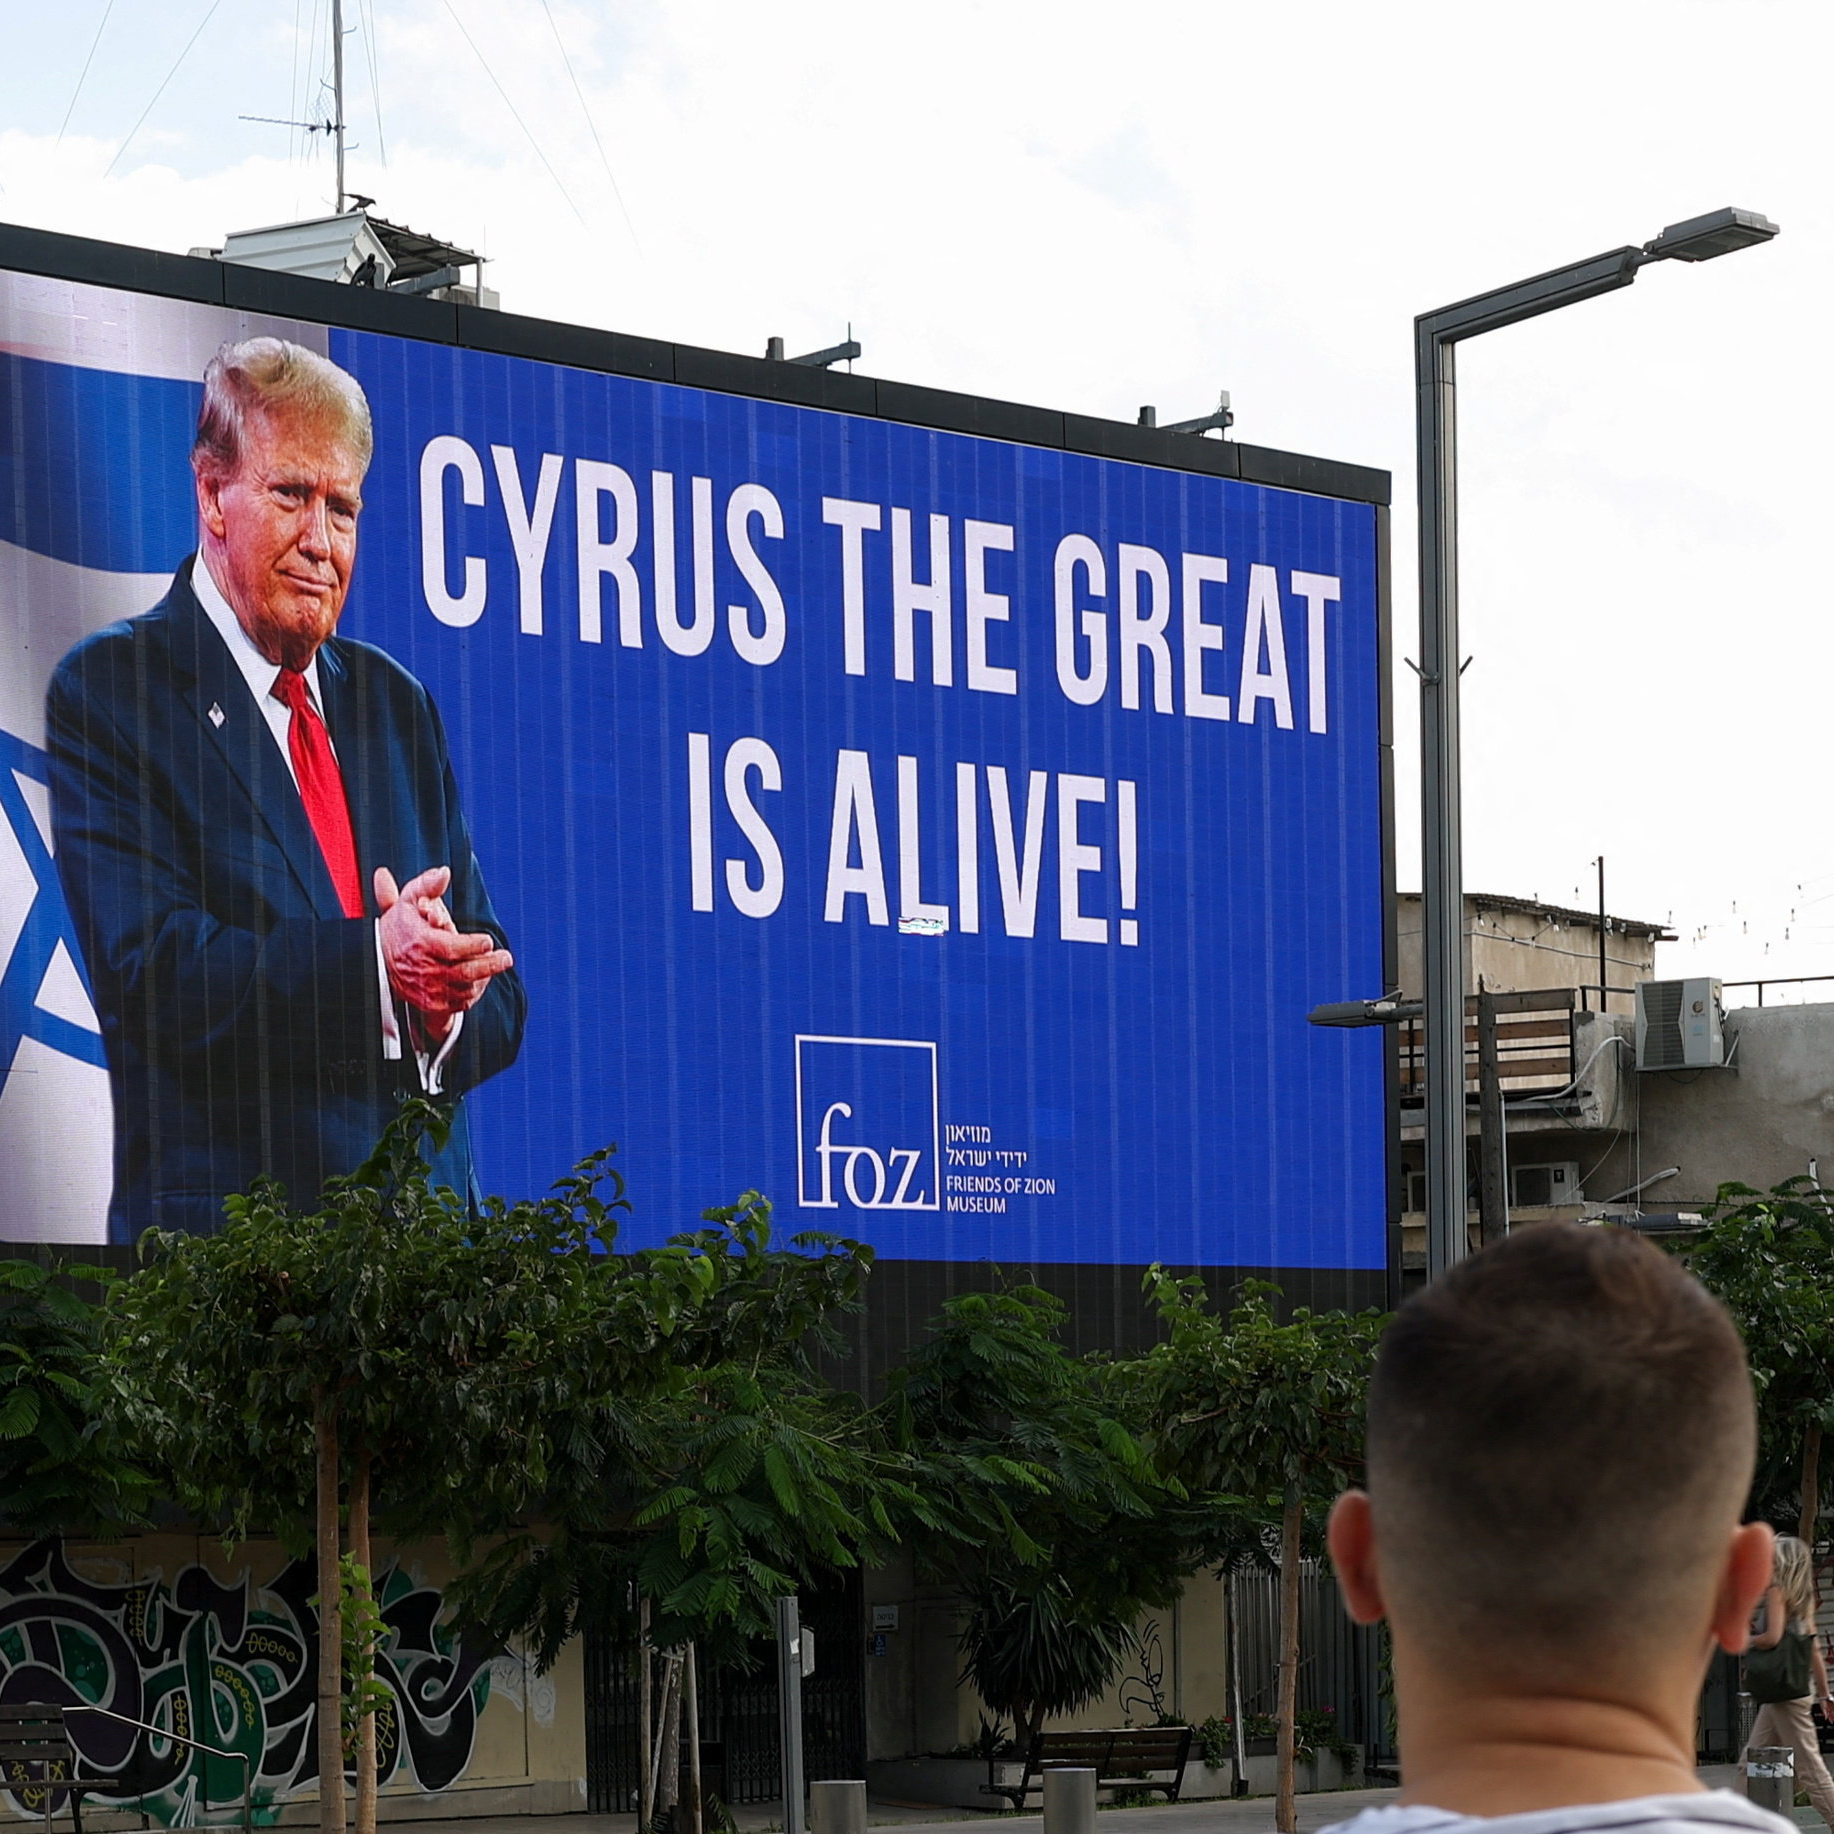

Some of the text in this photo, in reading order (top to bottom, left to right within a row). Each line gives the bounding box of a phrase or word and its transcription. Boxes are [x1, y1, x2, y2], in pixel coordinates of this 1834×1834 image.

[419, 434, 1342, 735] CYRUS THE GREAT
[687, 733, 1140, 948] IS ALIVE!
[944, 1124, 991, 1145] מוזיאון
[815, 1101, 925, 1208] foz
[945, 1145, 1028, 1169] ידידי ישראל
[946, 1175, 1056, 1195] FRIENDS OF ZION
[947, 1196, 1006, 1214] MUSEUM
